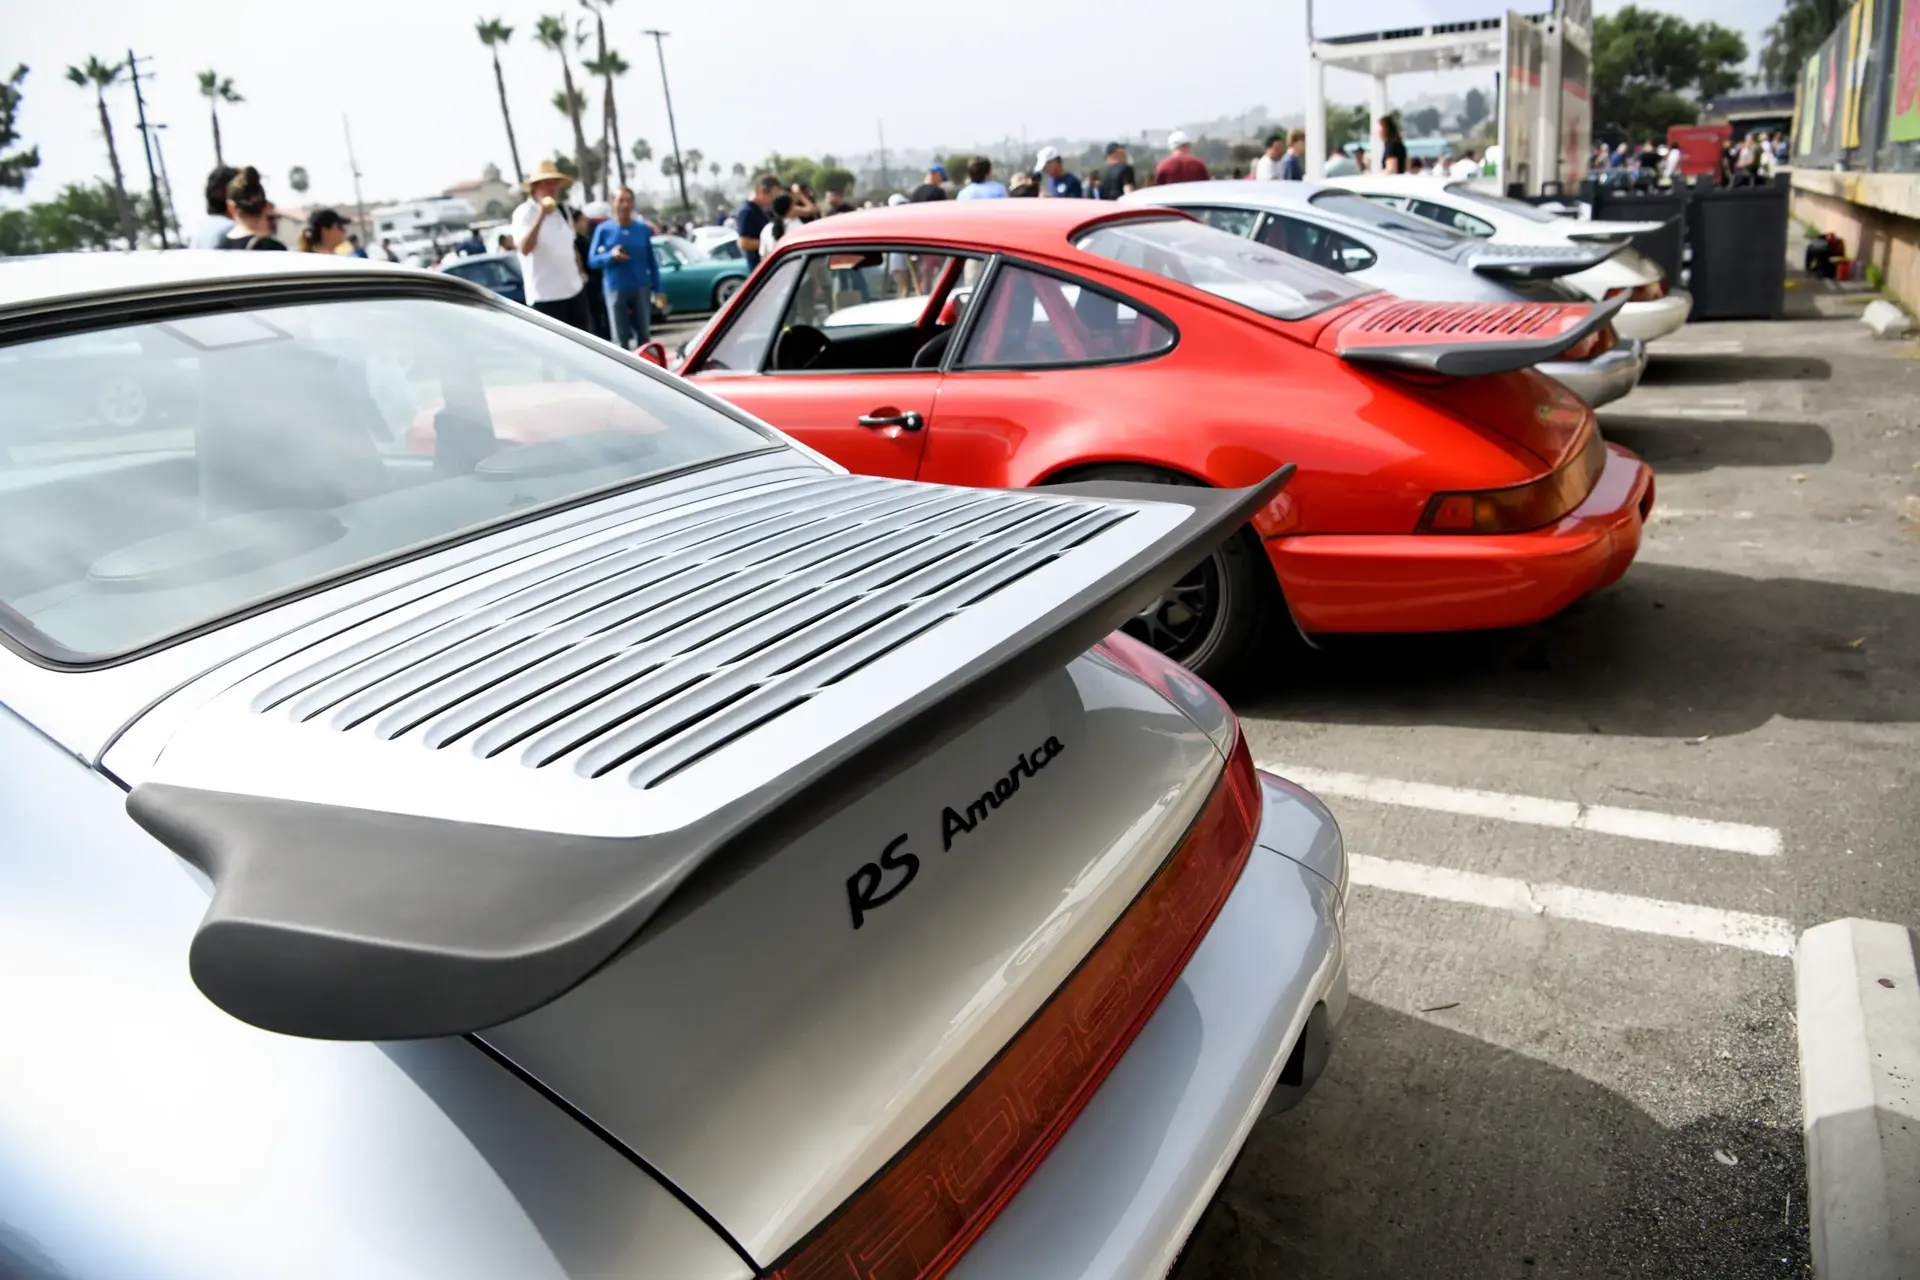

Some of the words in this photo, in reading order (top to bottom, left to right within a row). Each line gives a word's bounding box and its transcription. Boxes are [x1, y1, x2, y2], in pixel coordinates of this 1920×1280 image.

[846, 833, 920, 930] RS
[942, 736, 1065, 852] America
[844, 854, 1213, 1280] PORSC
